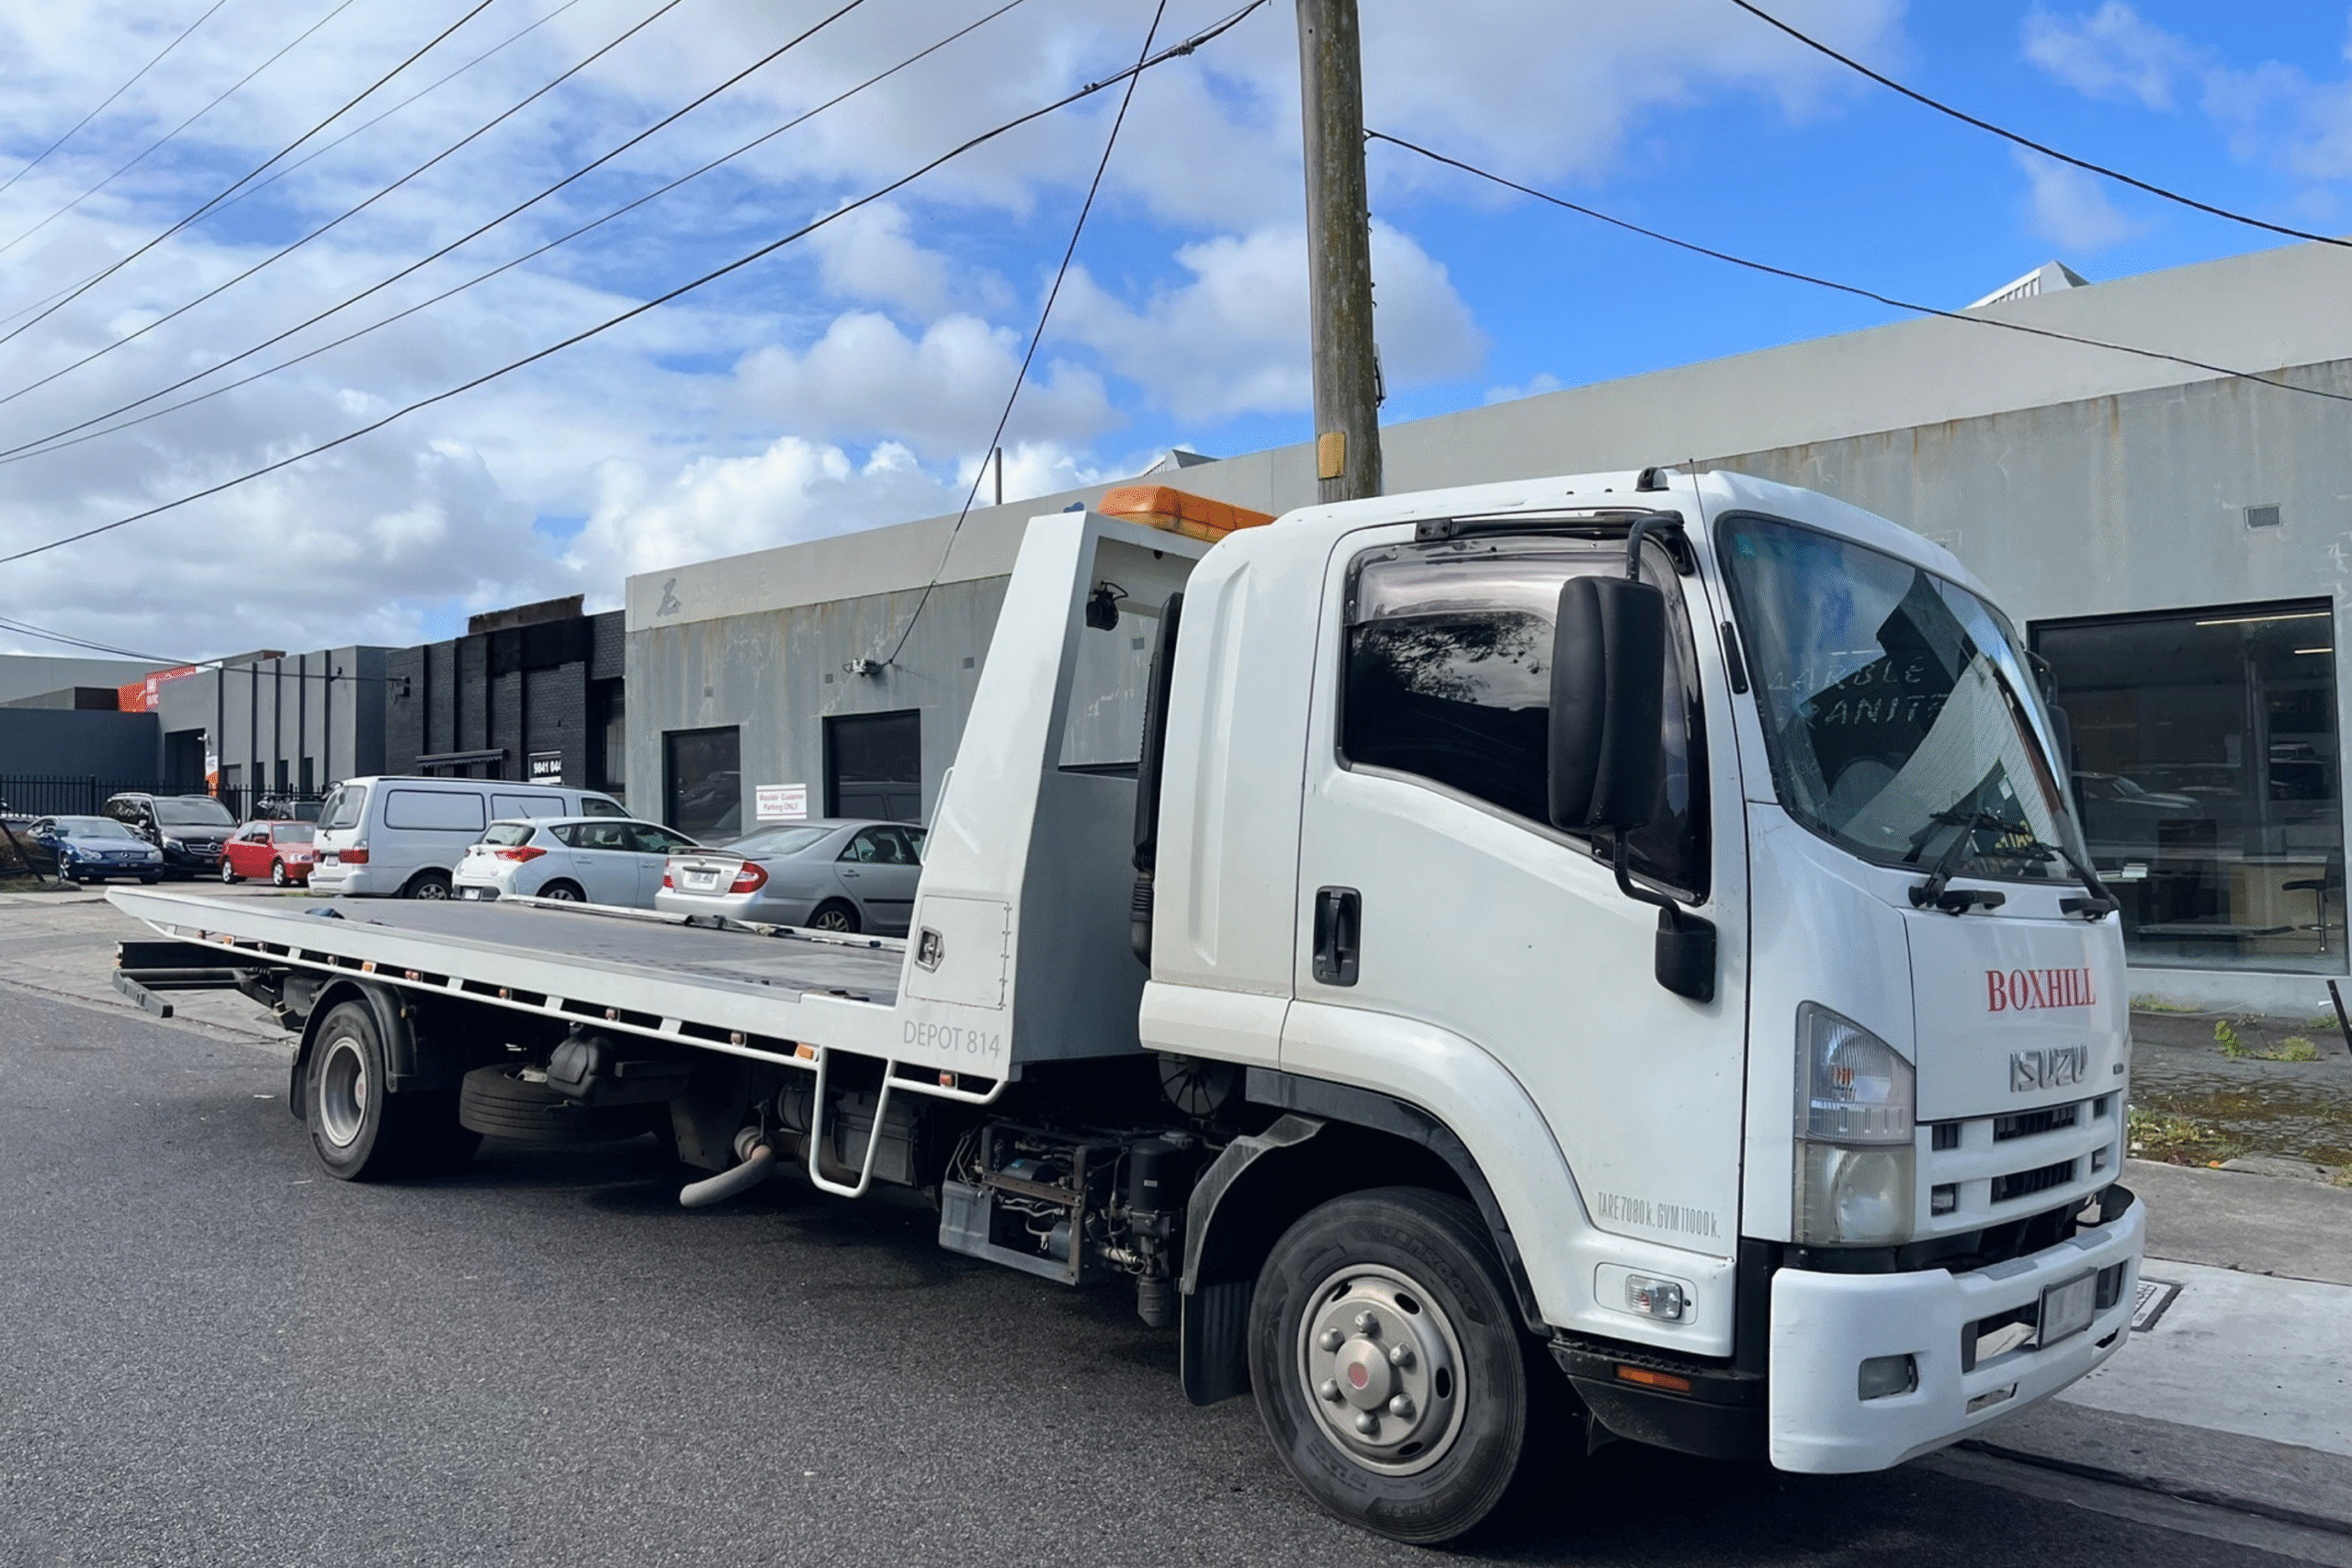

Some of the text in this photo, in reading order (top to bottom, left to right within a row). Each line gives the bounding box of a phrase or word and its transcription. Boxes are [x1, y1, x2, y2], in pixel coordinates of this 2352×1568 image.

[1984, 967, 2097, 1012] BOXHILL
[903, 1020, 1001, 1056] DEPOT 814
[2009, 1044, 2088, 1093] ISUZU
[1598, 1191, 1619, 1220] TARE
[1657, 1202, 1679, 1231] GVM
